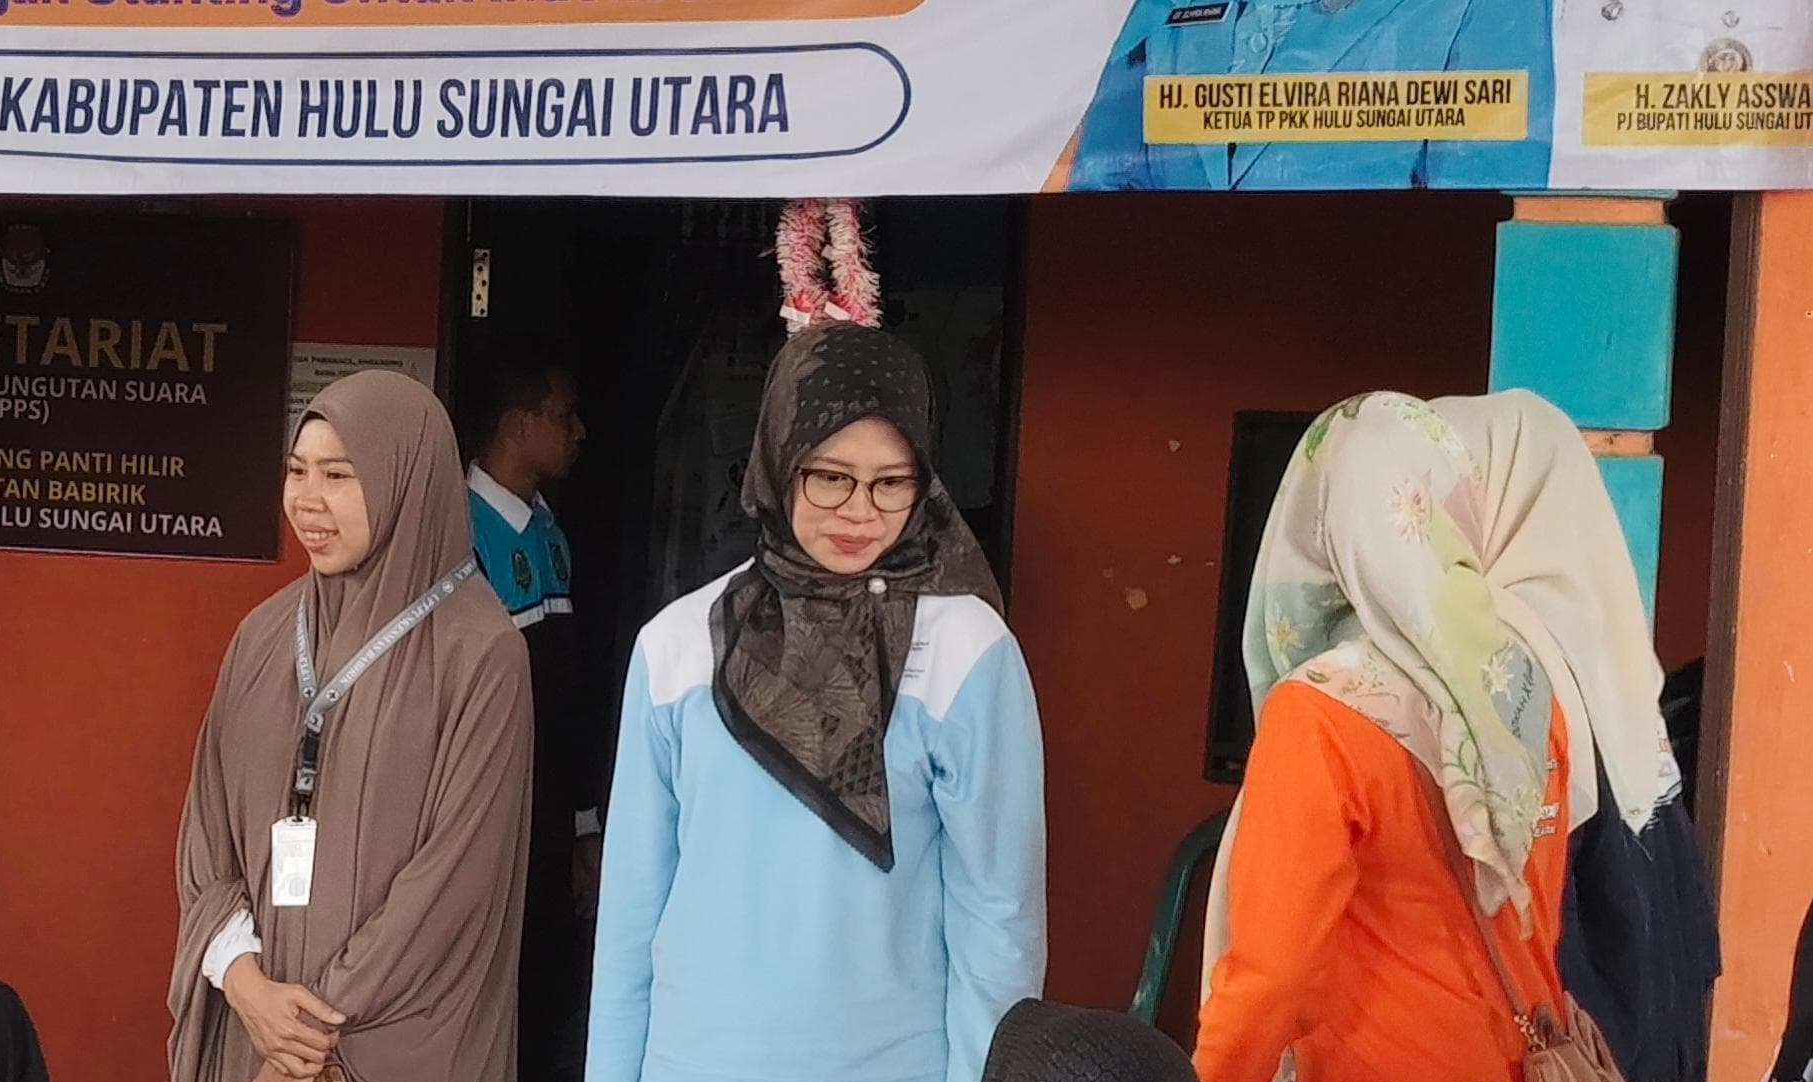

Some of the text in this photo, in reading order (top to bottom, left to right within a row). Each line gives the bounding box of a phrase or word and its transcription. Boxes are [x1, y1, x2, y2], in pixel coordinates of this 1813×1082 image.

[297, 79, 422, 139] HULU
[436, 77, 615, 139] SUNGAI
[629, 72, 789, 137] UTARA
[1159, 78, 1511, 109] HJ. GUSTI ELVIRA RIANA DEWI SARI
[1635, 83, 1656, 110] H.
[1662, 82, 1731, 110] ZAKLY
[1203, 107, 1466, 130] KETUA TP PKK HULU SUNGAI UTARA
[1617, 111, 1633, 131] PJ
[1636, 111, 1690, 131] BUPATI
[1693, 111, 1733, 131] HULU
[1736, 111, 1791, 131] SUNGAI
[124, 380, 207, 404] SUARA
[40, 450, 113, 475] PANTI
[121, 453, 186, 478] HILIR
[48, 480, 147, 506] BABIRIK
[38, 507, 134, 533] SUNGAI
[140, 512, 223, 538] UTARA
